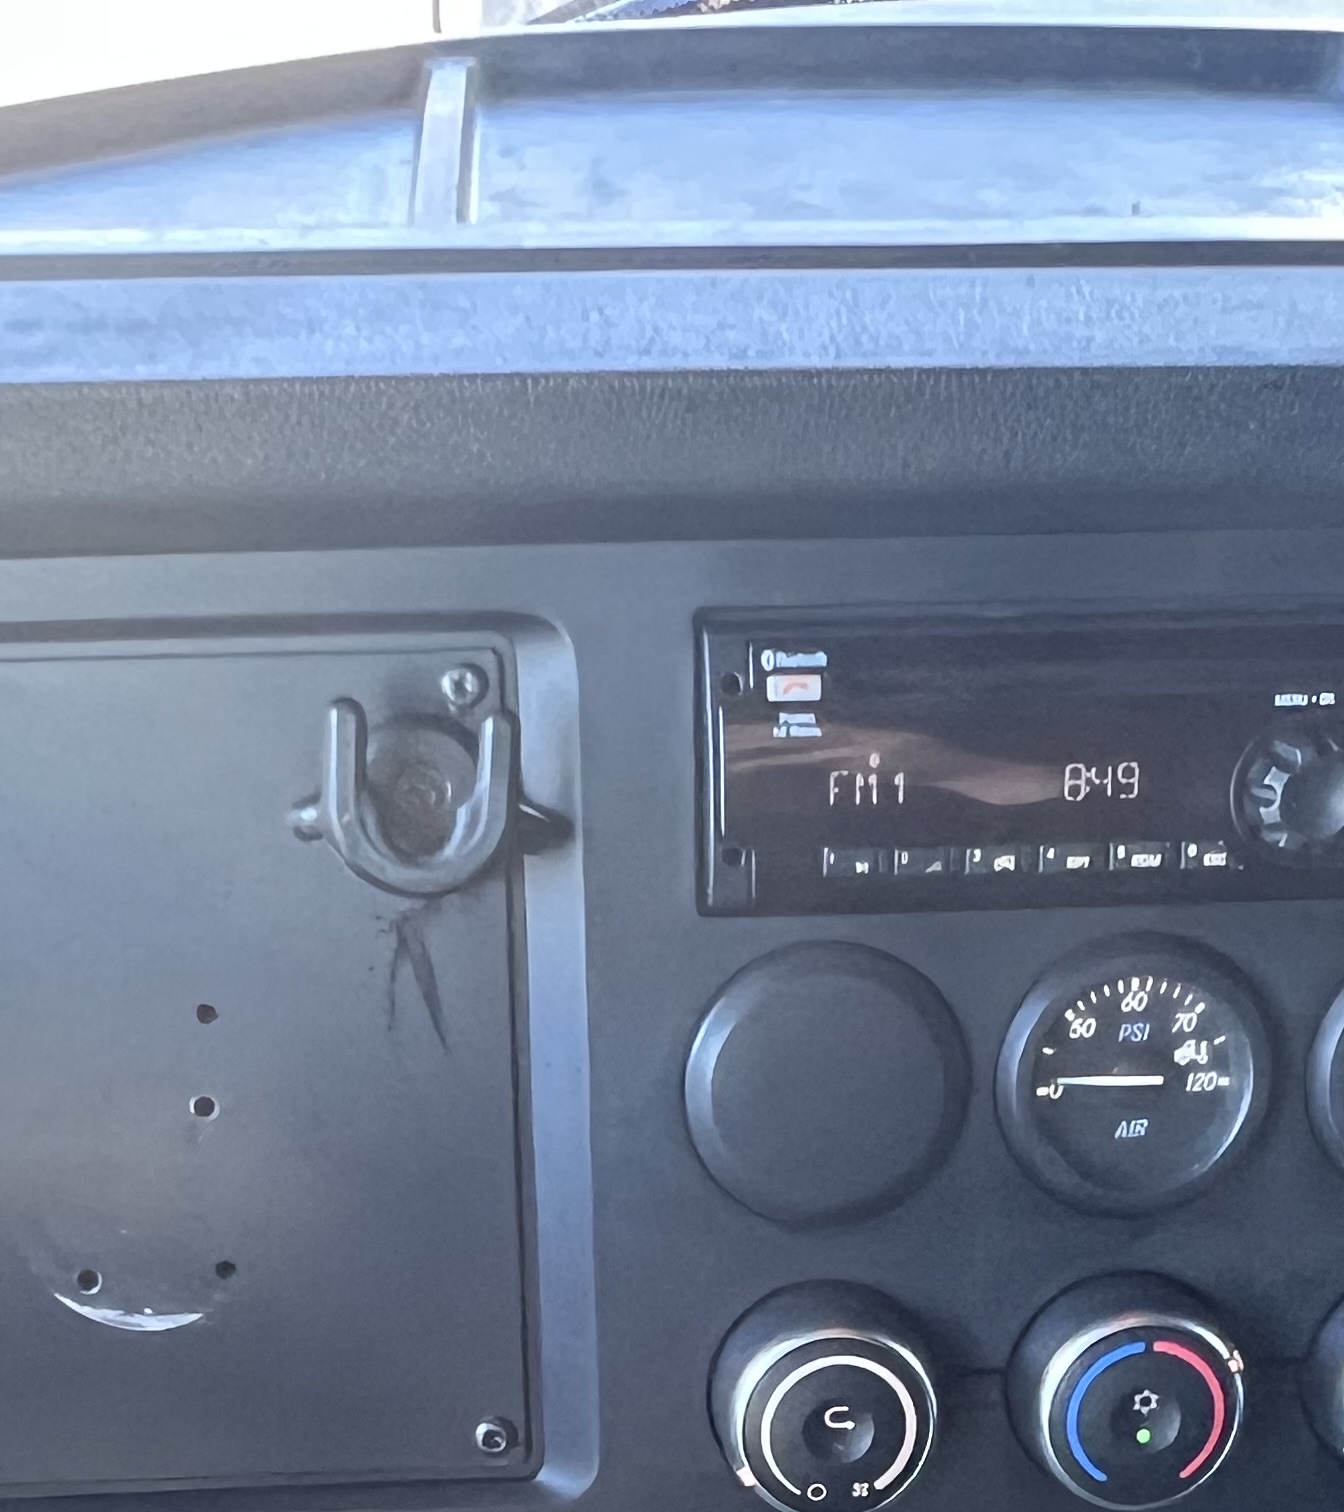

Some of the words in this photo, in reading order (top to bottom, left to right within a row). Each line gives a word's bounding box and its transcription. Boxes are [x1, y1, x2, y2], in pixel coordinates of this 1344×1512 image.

[1120, 991, 1149, 1013] 60
[1118, 1022, 1151, 1042] PSI
[1171, 1012, 1198, 1034] 70
[1185, 1071, 1218, 1092] 120
[1114, 1118, 1149, 1139] AIR
